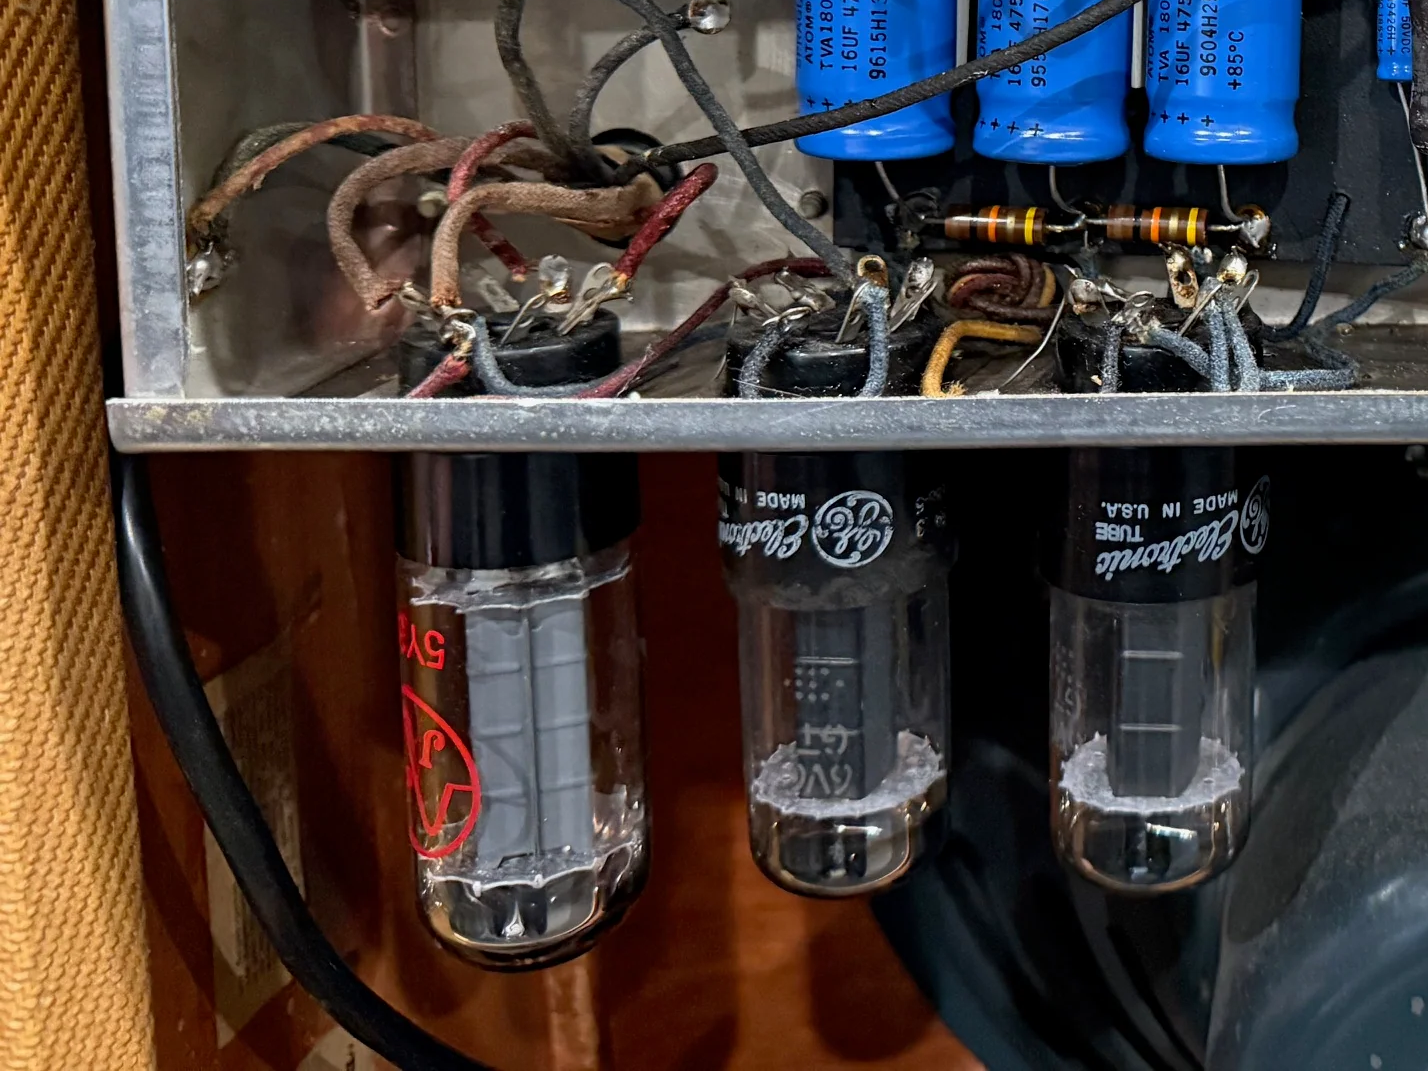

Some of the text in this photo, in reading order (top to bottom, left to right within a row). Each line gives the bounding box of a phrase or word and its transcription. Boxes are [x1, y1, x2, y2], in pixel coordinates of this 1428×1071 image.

[842, 25, 858, 71] 16UF
[1401, 16, 1410, 54] 50VDC
[1008, 40, 1021, 86] 16F
[1158, 50, 1169, 82] TVA
[1176, 40, 1190, 86] 16UF
[1227, 30, 1244, 90] +85°C
[756, 491, 805, 510] MADE
[1101, 489, 1238, 519] MADE IN U.S.A.
[1094, 522, 1144, 543] TUBE
[1094, 510, 1239, 581] Electronic
